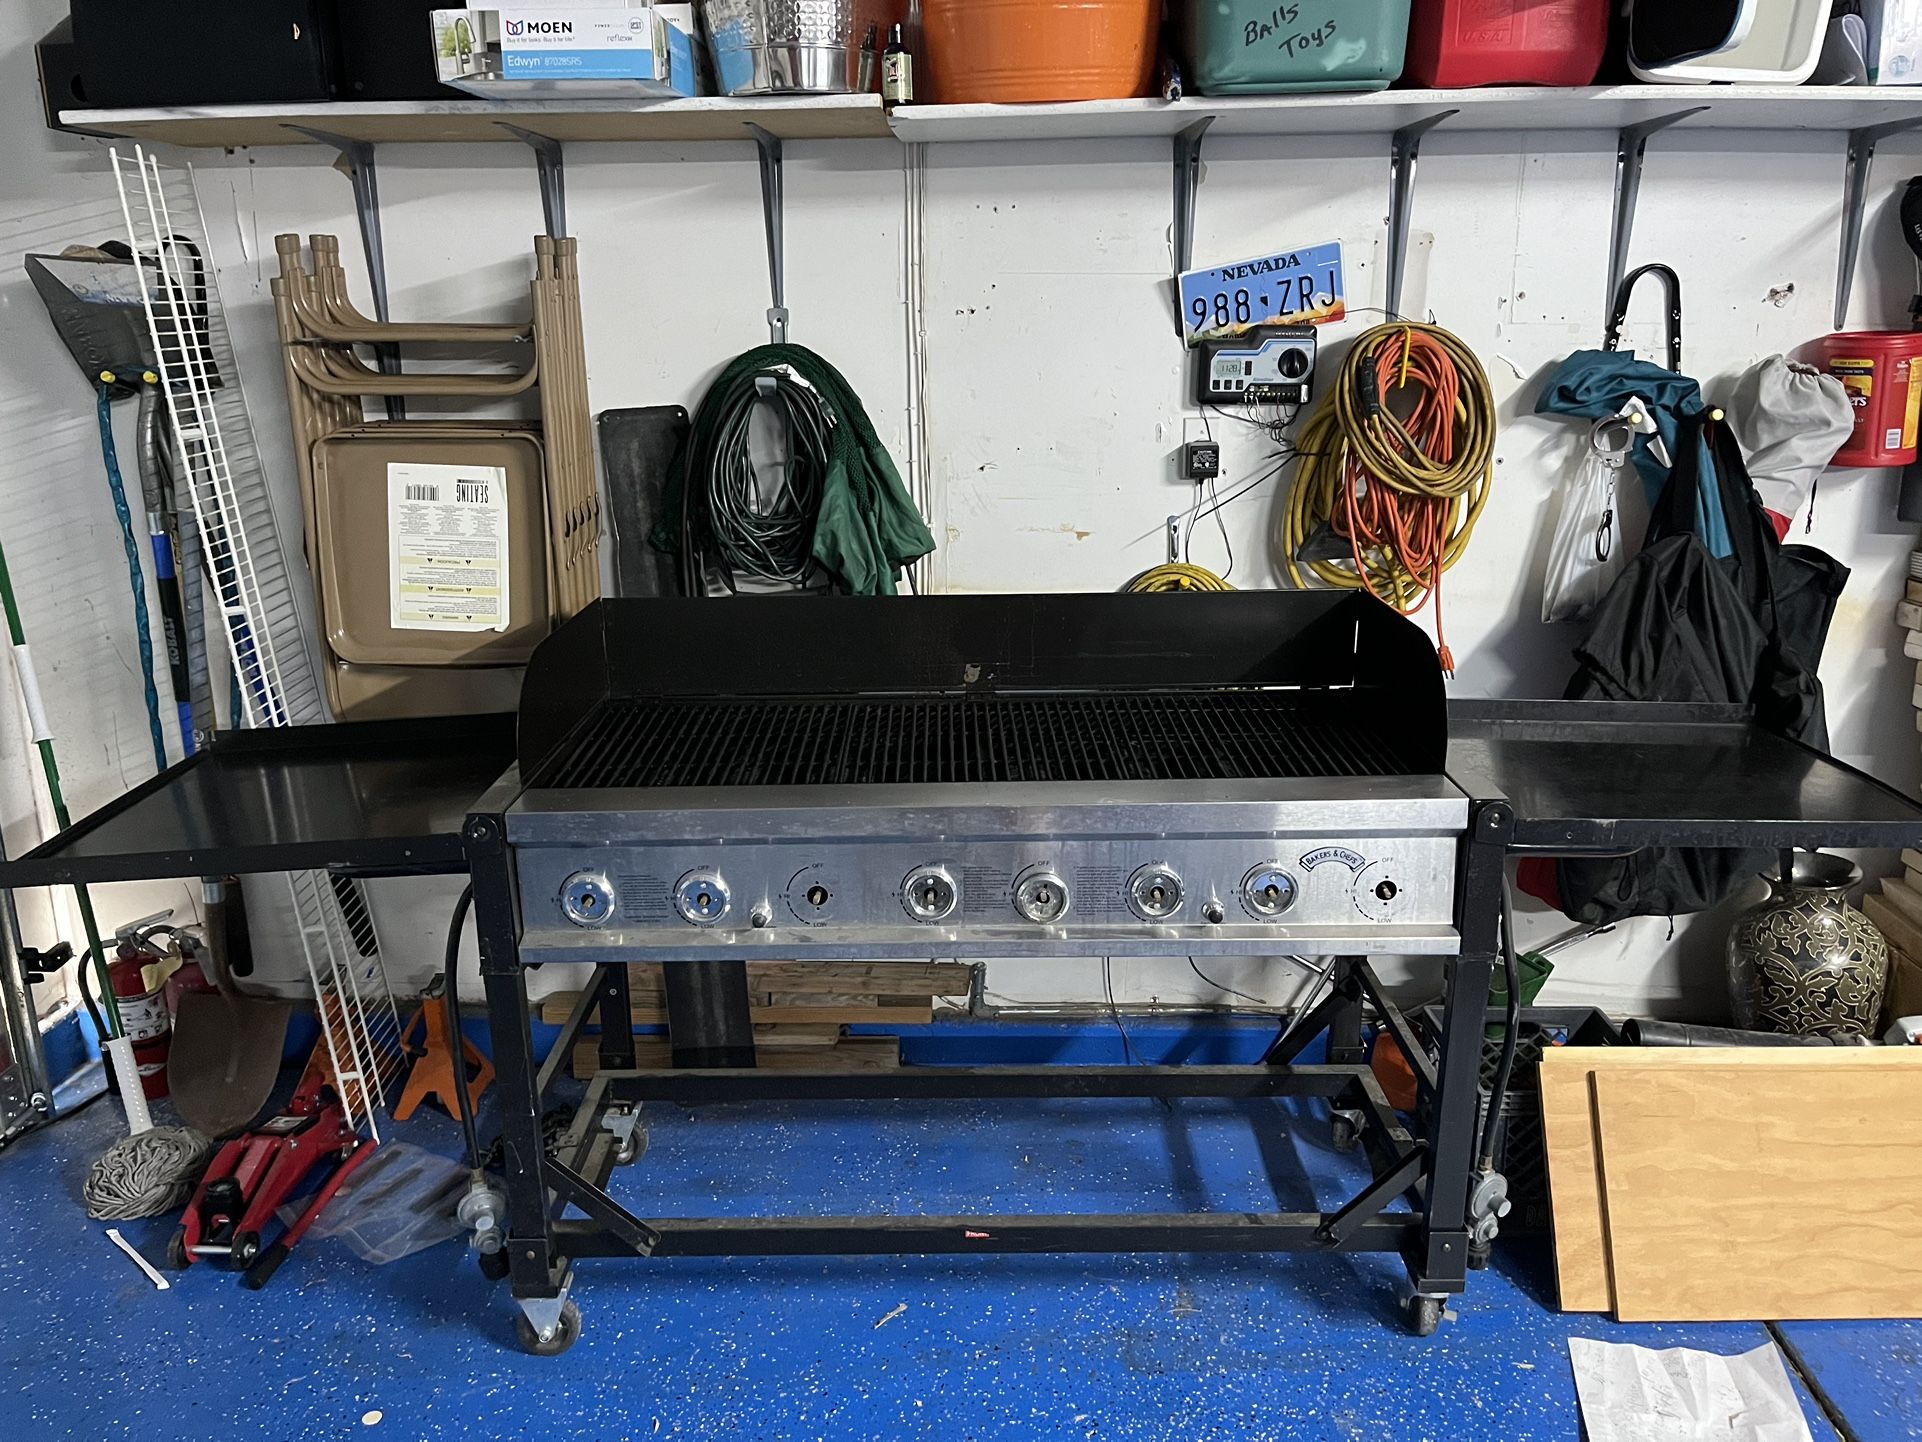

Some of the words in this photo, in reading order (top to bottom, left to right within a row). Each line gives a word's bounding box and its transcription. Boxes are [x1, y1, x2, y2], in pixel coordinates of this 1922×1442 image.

[527, 21, 573, 34] MOEN
[1222, 253, 1301, 282] NEVADA
[1192, 288, 1251, 334] 988
[1277, 270, 1337, 317] ZRJ
[457, 484, 489, 504] SEATING
[163, 615, 181, 666] KOBALT
[1305, 851, 1331, 865] BAKERS
[1332, 849, 1338, 857] &
